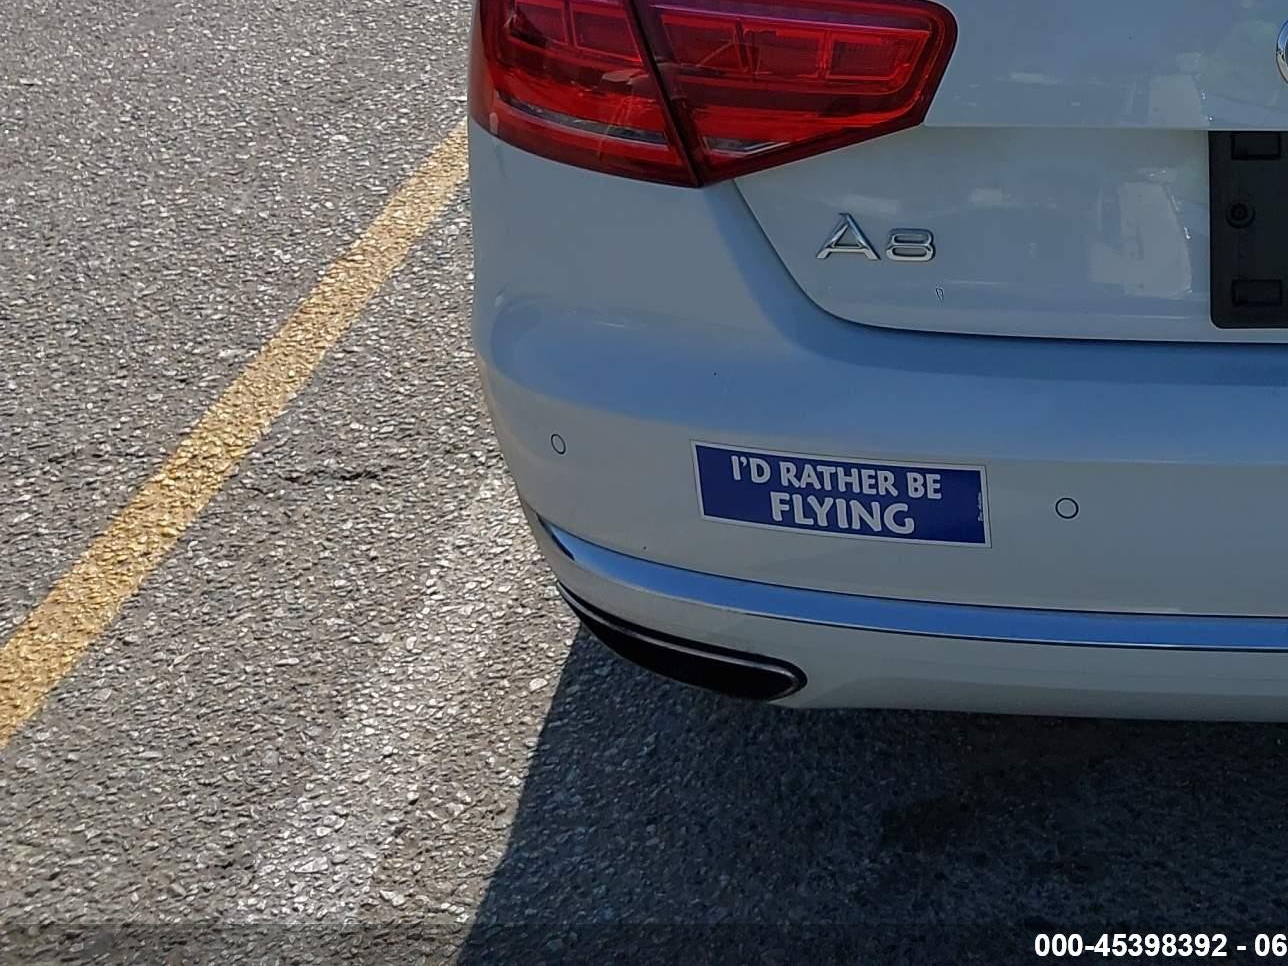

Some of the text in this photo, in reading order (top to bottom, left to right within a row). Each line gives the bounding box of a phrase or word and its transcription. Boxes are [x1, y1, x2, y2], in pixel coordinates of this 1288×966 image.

[816, 212, 936, 262] A8
[730, 455, 942, 500] I'D RATHER BE
[769, 491, 915, 535] FLYING
